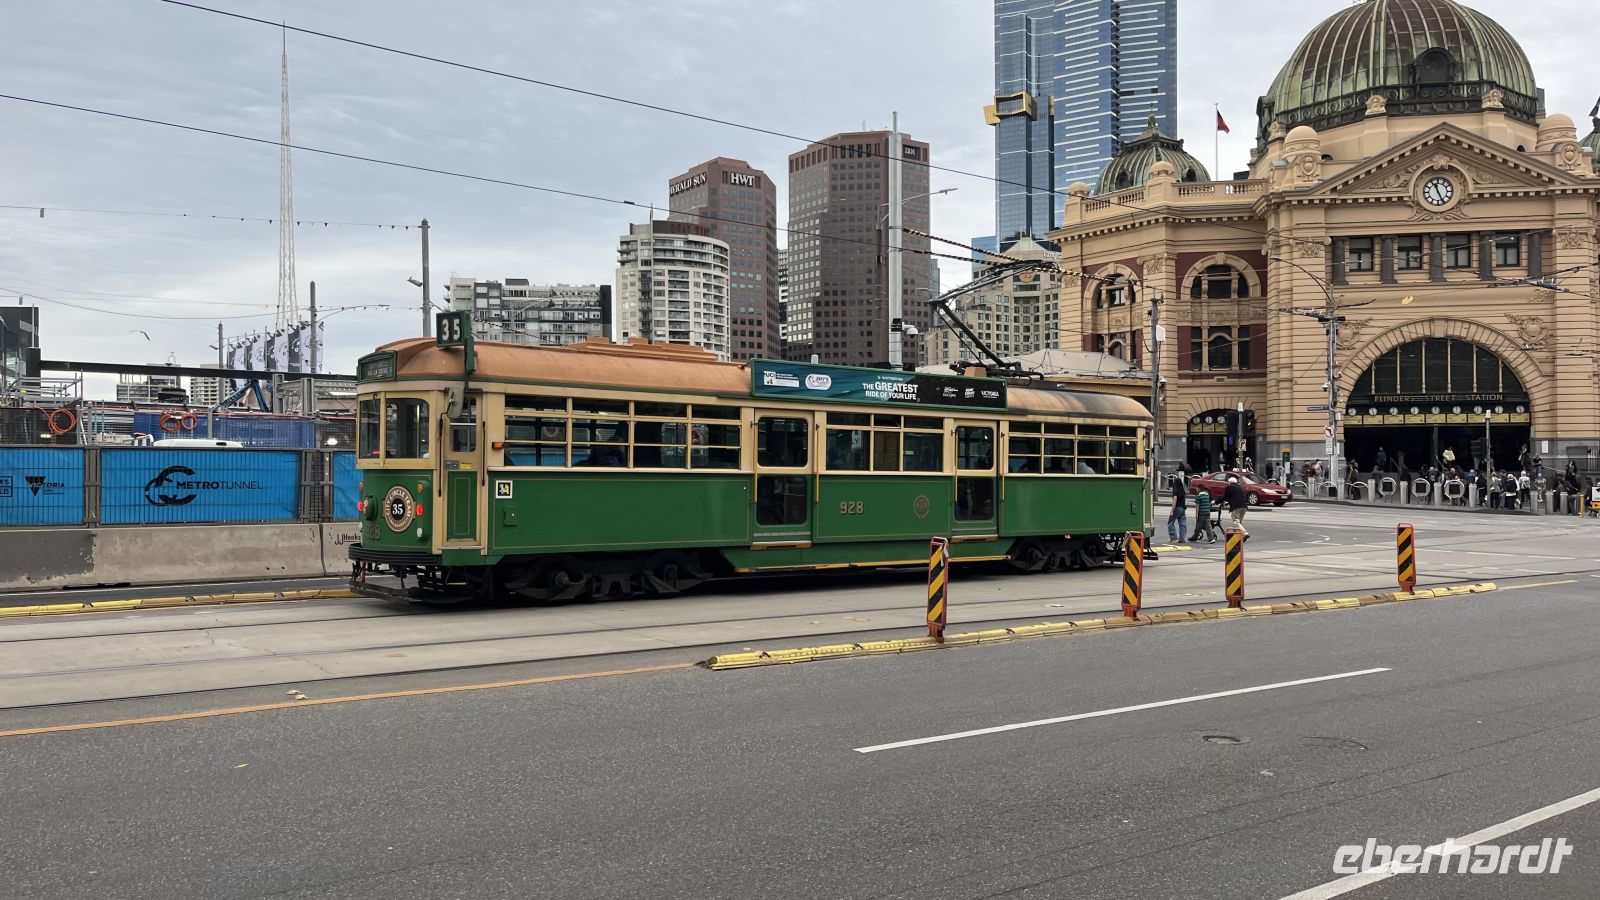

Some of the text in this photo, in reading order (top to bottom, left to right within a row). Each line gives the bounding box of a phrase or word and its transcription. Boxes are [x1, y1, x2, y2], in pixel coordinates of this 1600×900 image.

[693, 173, 706, 187] SUN
[730, 172, 754, 186] HWT
[442, 318, 460, 341] 35
[865, 390, 880, 398] RIDE
[874, 381, 919, 393] GREATEST
[1425, 394, 1457, 402] STREET
[389, 490, 406, 500] CIRCLE
[404, 496, 412, 518] TRAM
[392, 503, 404, 516] 35
[840, 501, 864, 515] 928
